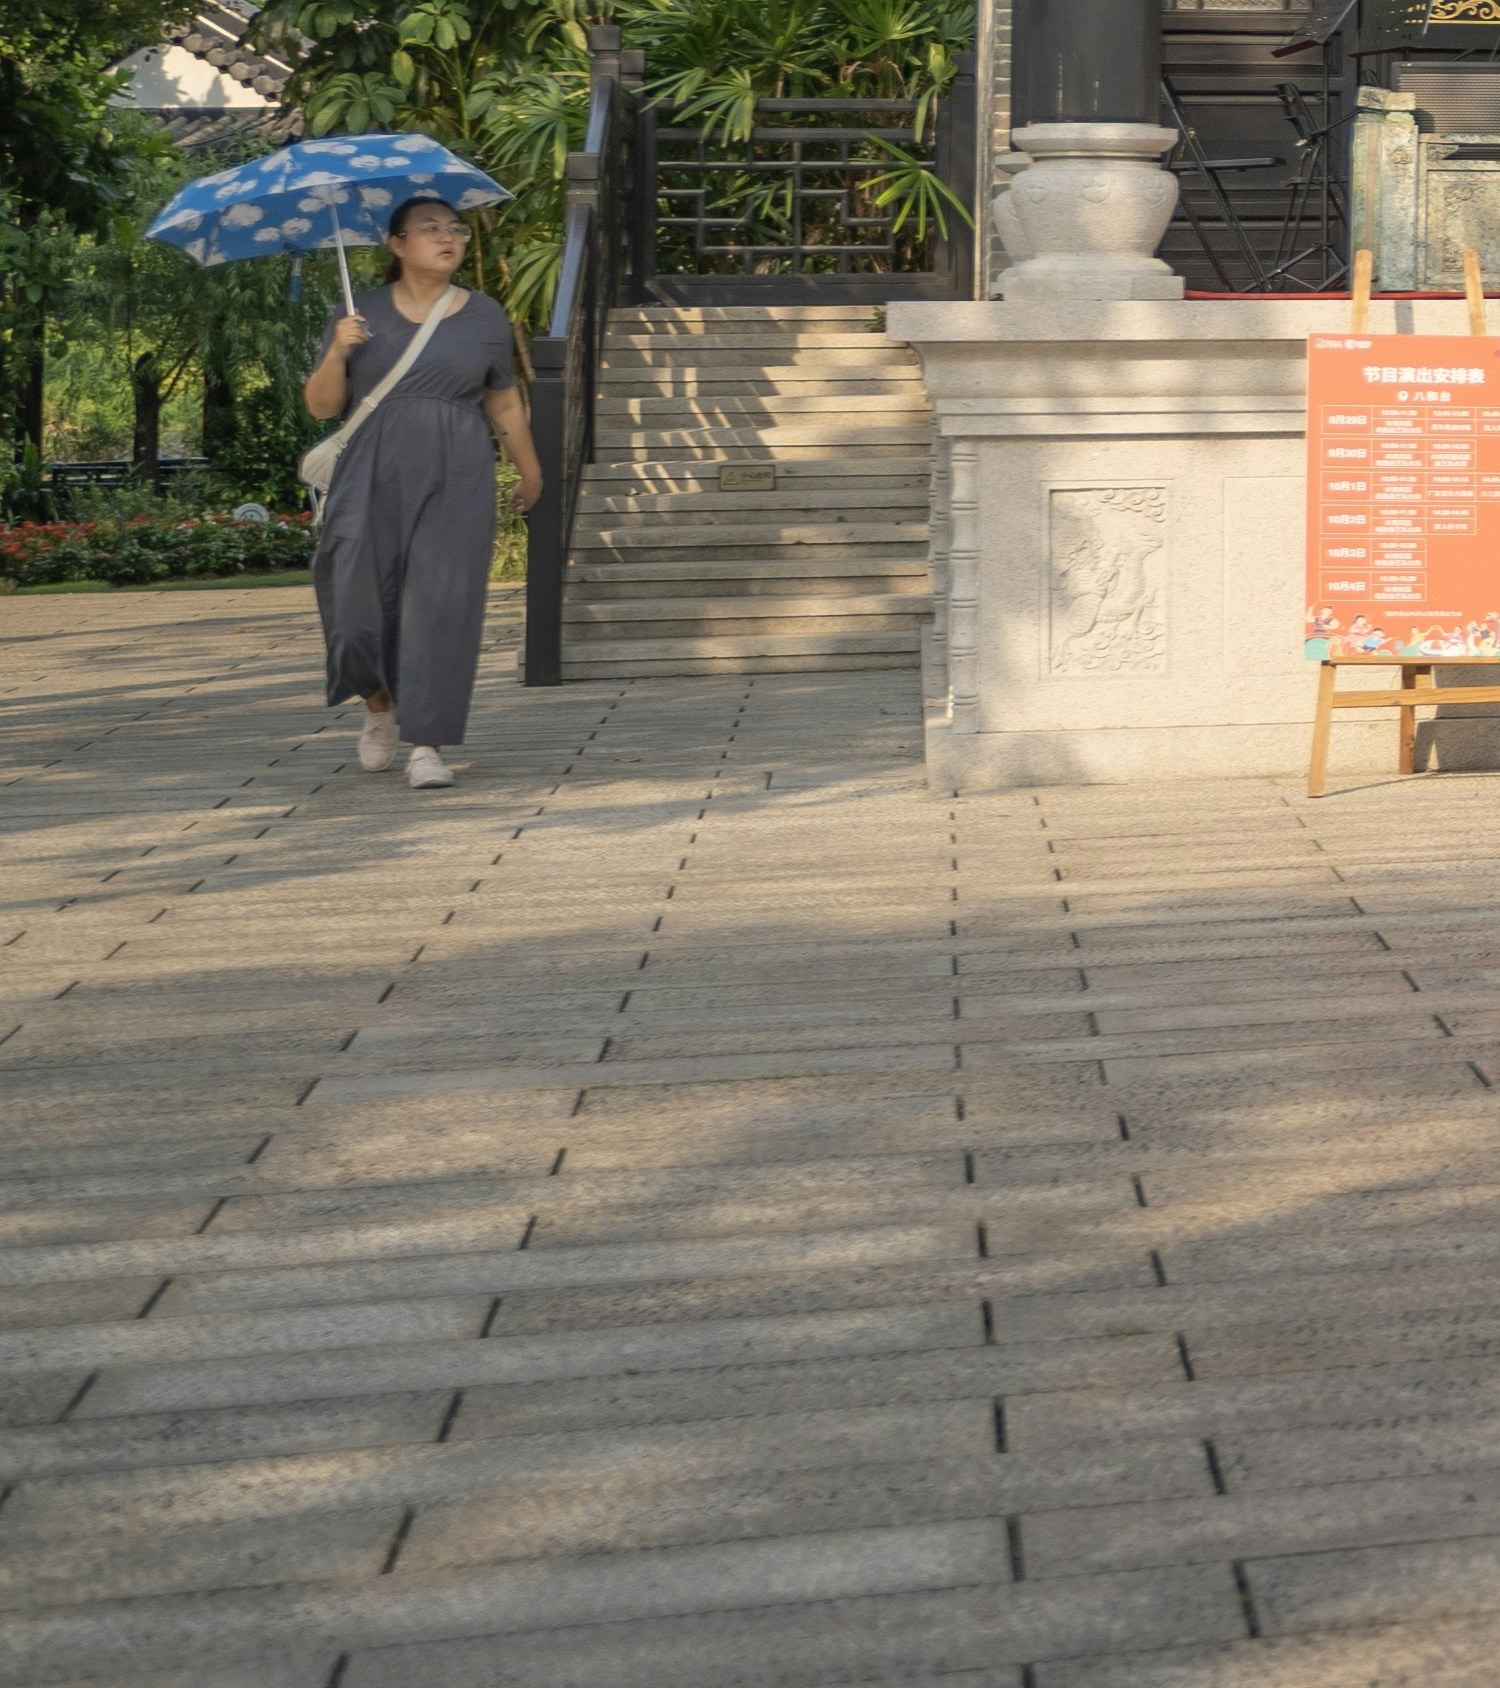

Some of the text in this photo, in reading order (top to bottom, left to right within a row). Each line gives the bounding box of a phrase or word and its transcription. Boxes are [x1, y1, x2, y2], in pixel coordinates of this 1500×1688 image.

[1363, 365, 1486, 385] 节目演出安排表
[1413, 390, 1452, 403] 八和台
[1327, 447, 1367, 459] 9月30日
[1328, 480, 1367, 492] 10月1日
[1328, 514, 1366, 525] 10月2日
[1327, 547, 1366, 559] 10月3日
[1327, 581, 1366, 592] 10月4日
